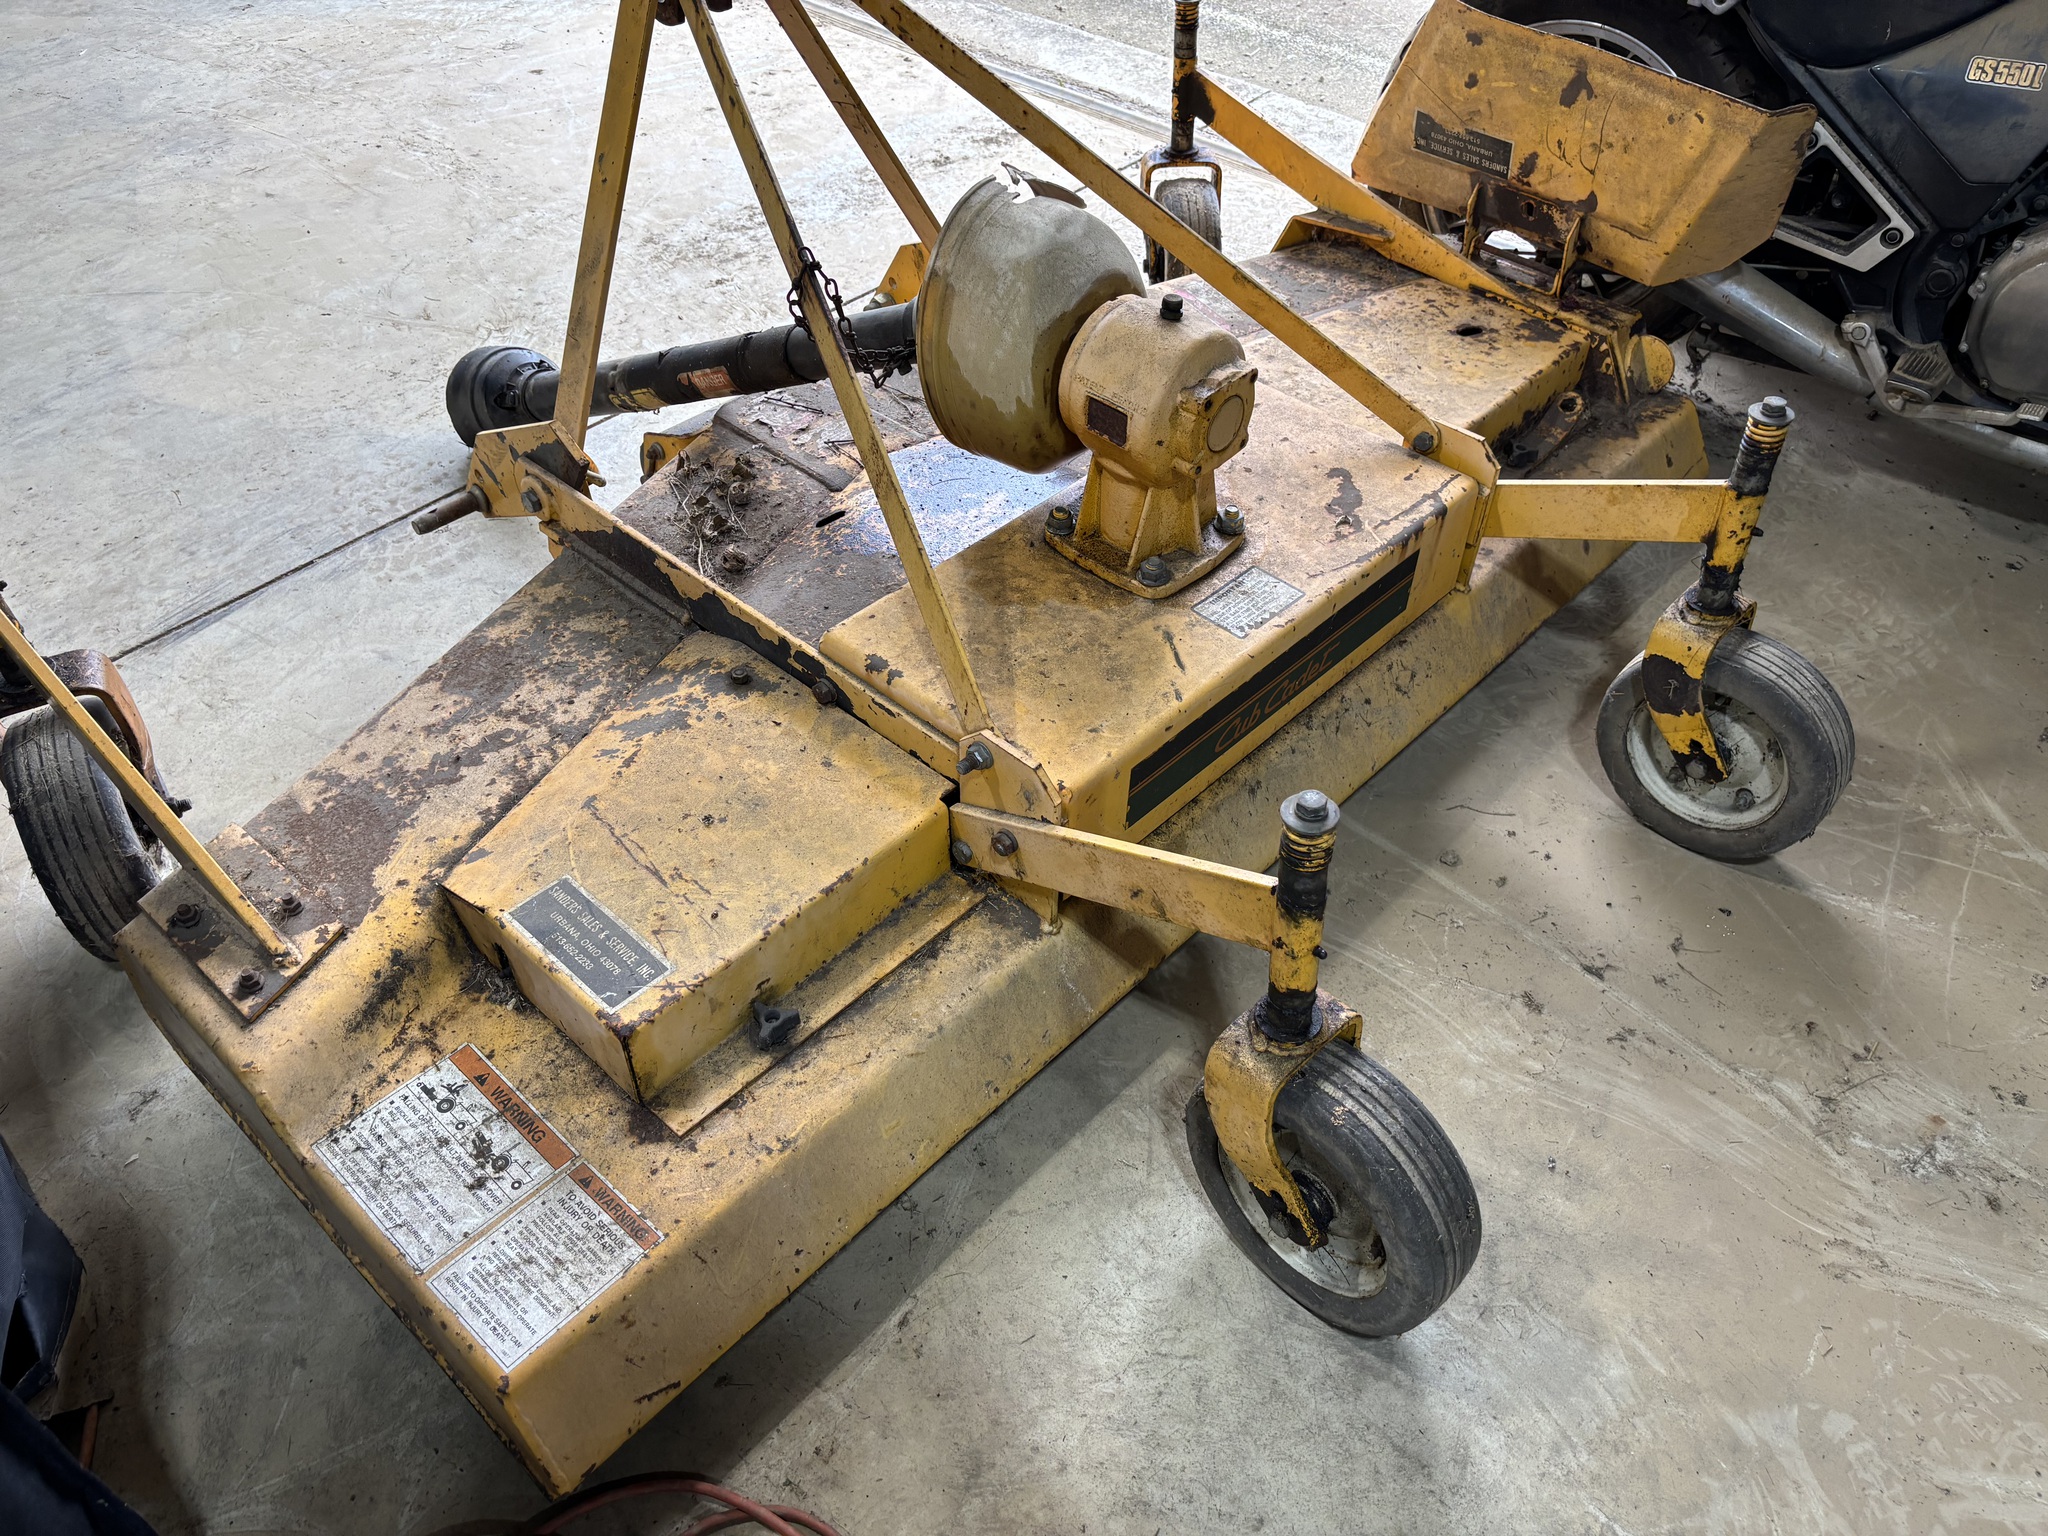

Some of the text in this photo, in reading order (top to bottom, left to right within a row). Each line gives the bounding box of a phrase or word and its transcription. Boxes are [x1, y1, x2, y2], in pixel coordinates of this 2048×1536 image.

[1968, 57, 2046, 89] GS550L
[1447, 136, 1464, 148] OHIO
[1454, 149, 1460, 158] &
[1461, 151, 1480, 165] SALES
[1480, 157, 1508, 174] SANDERS
[1208, 577, 1249, 605] IMPORTANT
[1215, 641, 1340, 752] Cub Cadet
[546, 885, 658, 981] SANDERS SALES & SERVICE, INC.
[547, 910, 623, 976] URBANA, OHIO 43078
[549, 931, 596, 971] 513-652-2233
[487, 1084, 549, 1144] WARNING
[323, 1142, 343, 1162] RESULT
[342, 1164, 365, 1187] SERIOUS
[359, 1184, 379, 1204] INJURY
[374, 1201, 386, 1212] OR
[366, 1126, 457, 1226] RAISED MOWER CAN DROP AND CRUSH
[393, 1104, 412, 1124] BUCKLE
[470, 1190, 483, 1203] AND
[479, 1199, 494, 1214] SEAT
[397, 1093, 421, 1116] FALLING
[425, 1123, 440, 1137] CAN
[458, 1160, 478, 1179] BEING
[484, 1188, 503, 1207] OVER
[331, 1137, 352, 1158] ALLING
[384, 1200, 404, 1220] BLOCK
[399, 1217, 426, 1246] SECURELY
[421, 1243, 437, 1258] CAN
[405, 1189, 428, 1212] REMOVE
[423, 1210, 438, 1223] KEY
[433, 1221, 455, 1244] BEFORE
[555, 1196, 584, 1222] INJURY
[579, 1219, 594, 1234] OR
[563, 1189, 627, 1250] TO AVOID SERIOUS
[591, 1186, 650, 1241] WARNING
[509, 1235, 530, 1256] OPERATE
[553, 1281, 576, 1303] TRACTOR
[594, 1264, 608, 1277] AND
[443, 1275, 508, 1345] RESULT IN INJURY OR DEATH.
[449, 1270, 523, 1349] FAILURE TO OPERATE SAFELY CAN
[509, 1307, 519, 1317] TO
[515, 1313, 537, 1336] OPERATE
[518, 1305, 529, 1316] OR
